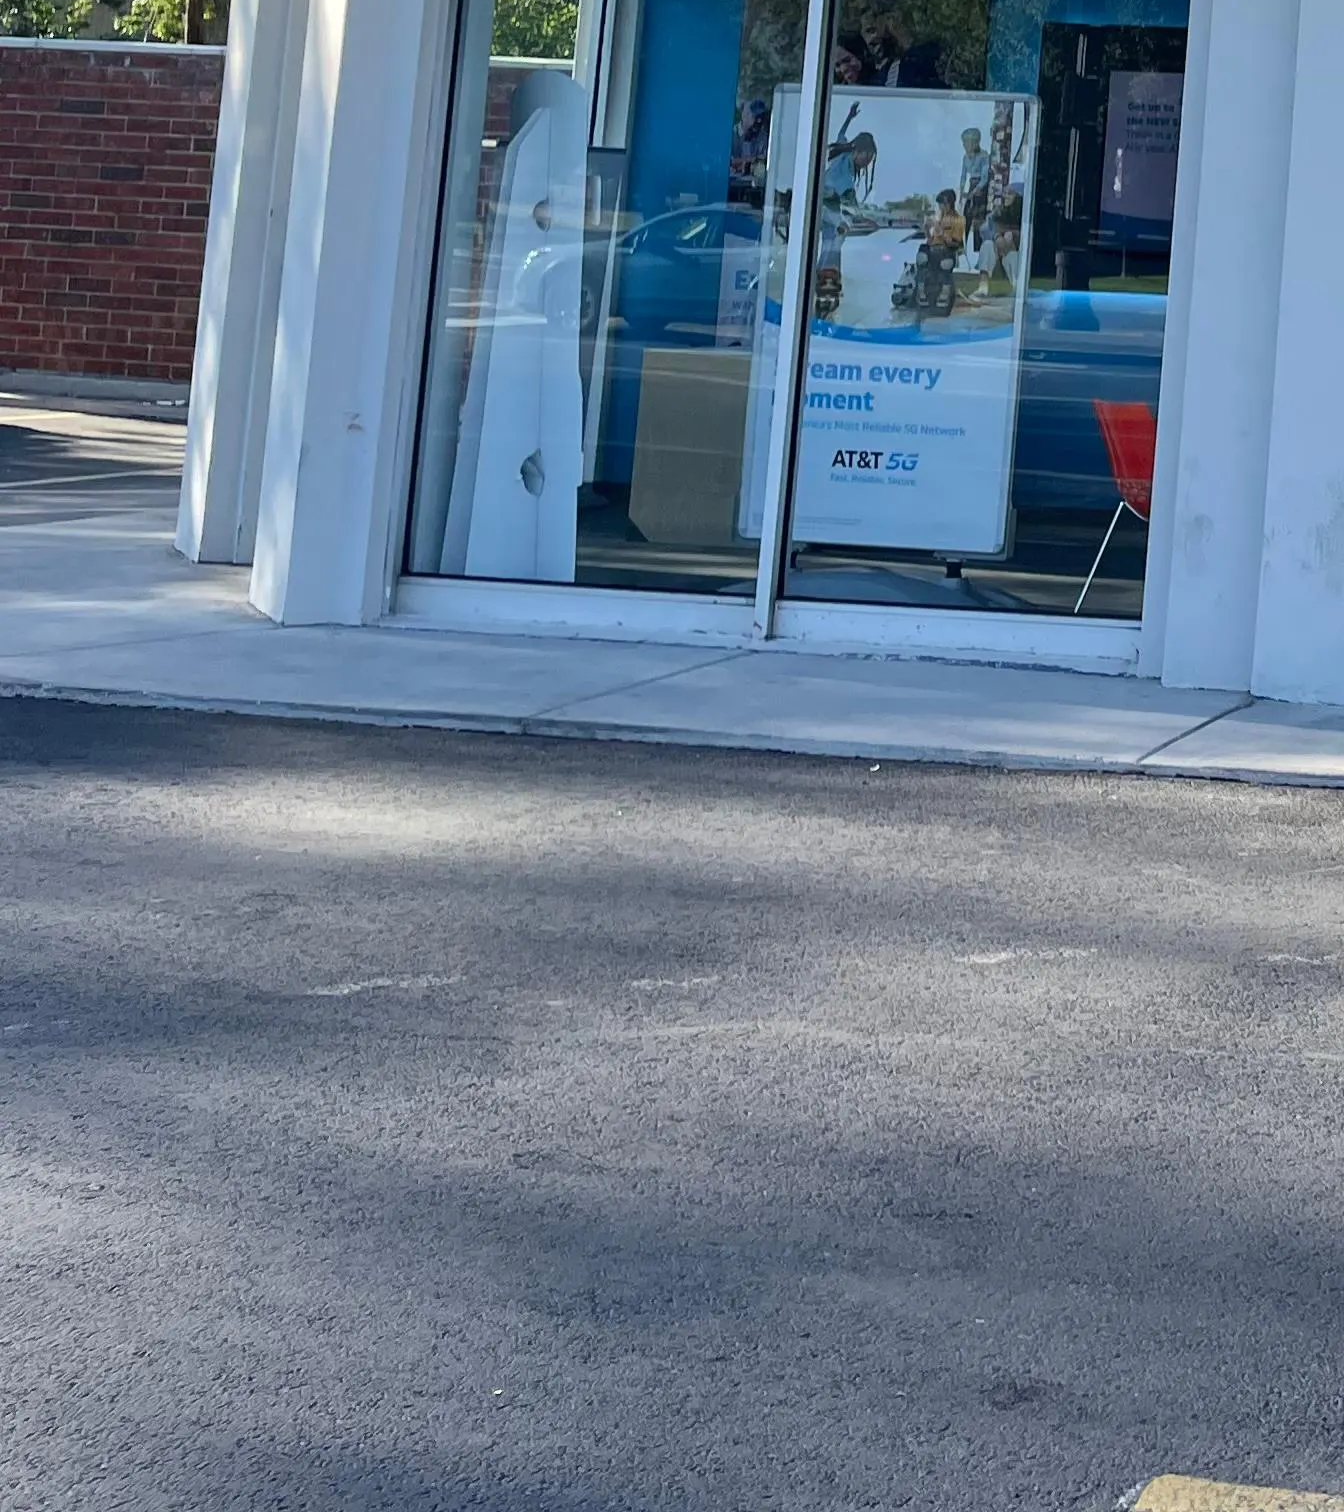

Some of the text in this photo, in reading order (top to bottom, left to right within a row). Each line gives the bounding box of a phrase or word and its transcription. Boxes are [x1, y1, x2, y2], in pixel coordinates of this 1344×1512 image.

[868, 365, 942, 390] every
[862, 422, 901, 434] Reliable
[904, 424, 918, 436] 5G
[920, 426, 966, 438] Network
[831, 449, 920, 471] AT&T 5G
